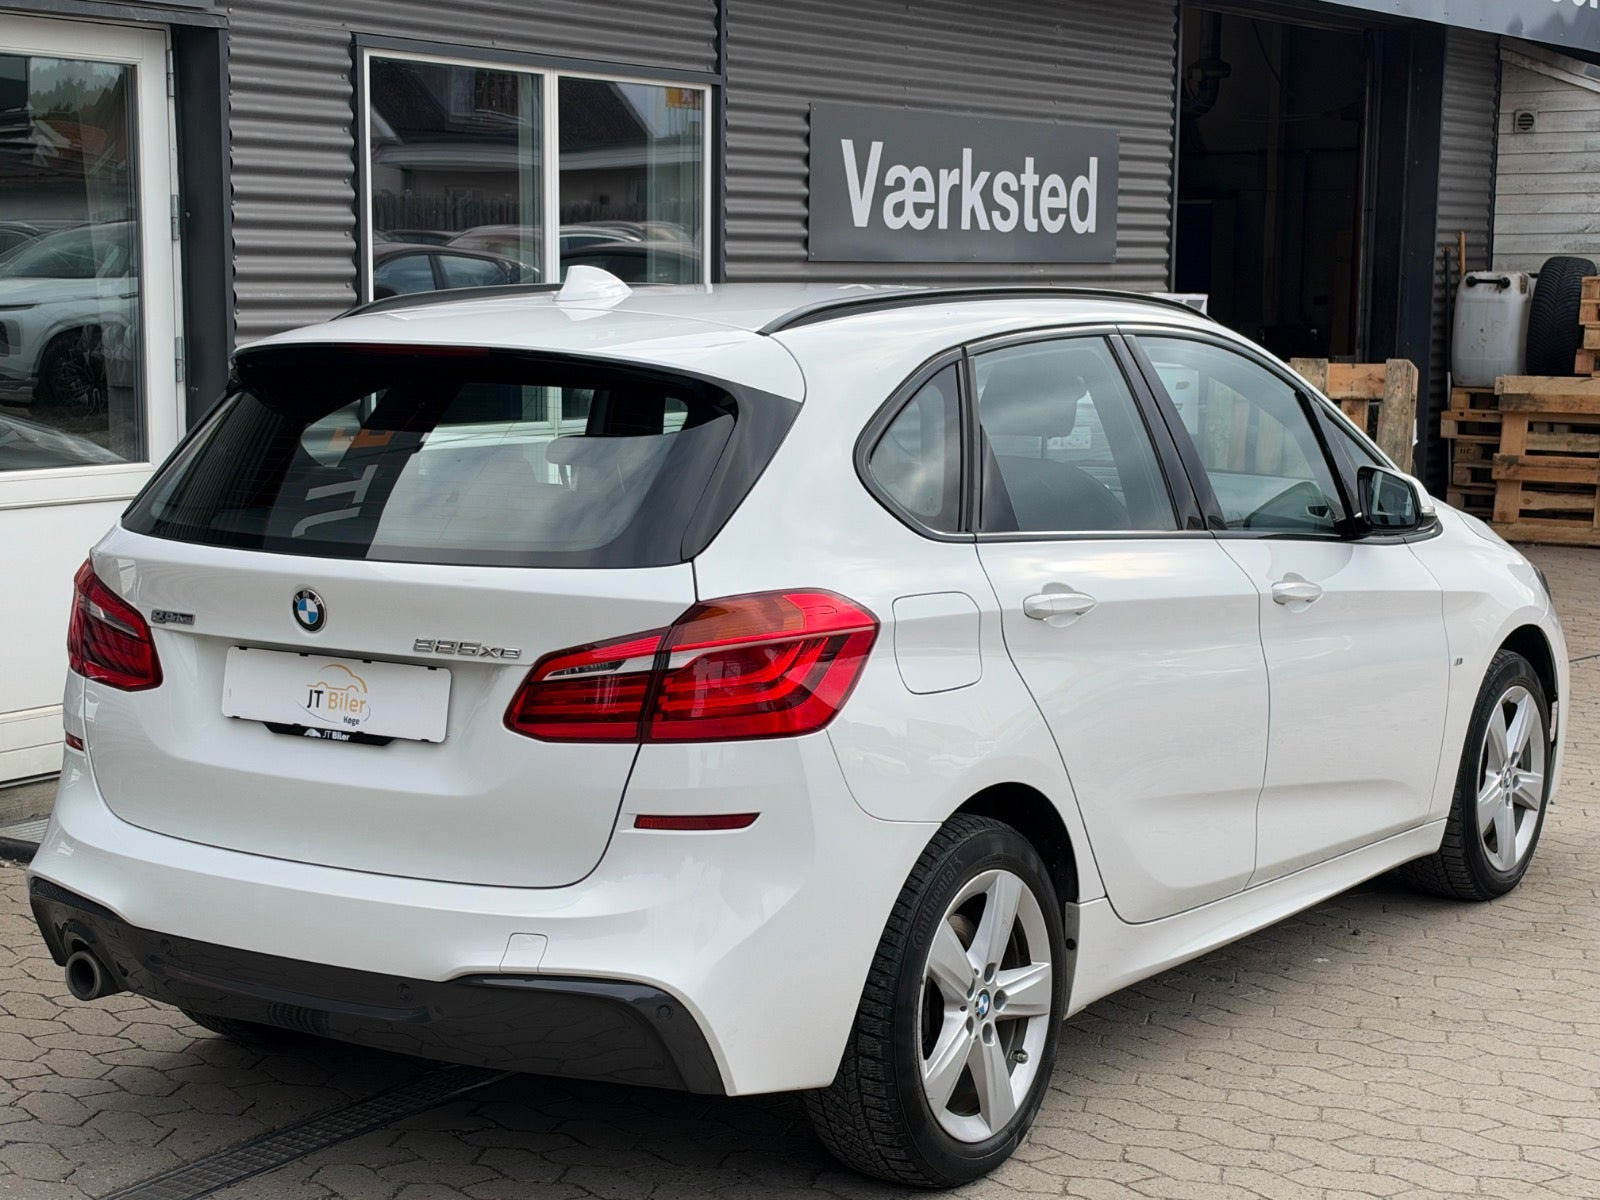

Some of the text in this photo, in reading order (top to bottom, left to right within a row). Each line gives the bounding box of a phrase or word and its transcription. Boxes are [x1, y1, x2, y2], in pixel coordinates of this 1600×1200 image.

[841, 138, 1098, 234] Værksted
[306, 689, 367, 713] JT Biler
[343, 716, 360, 727] Køge
[322, 730, 351, 741] JT Biler
